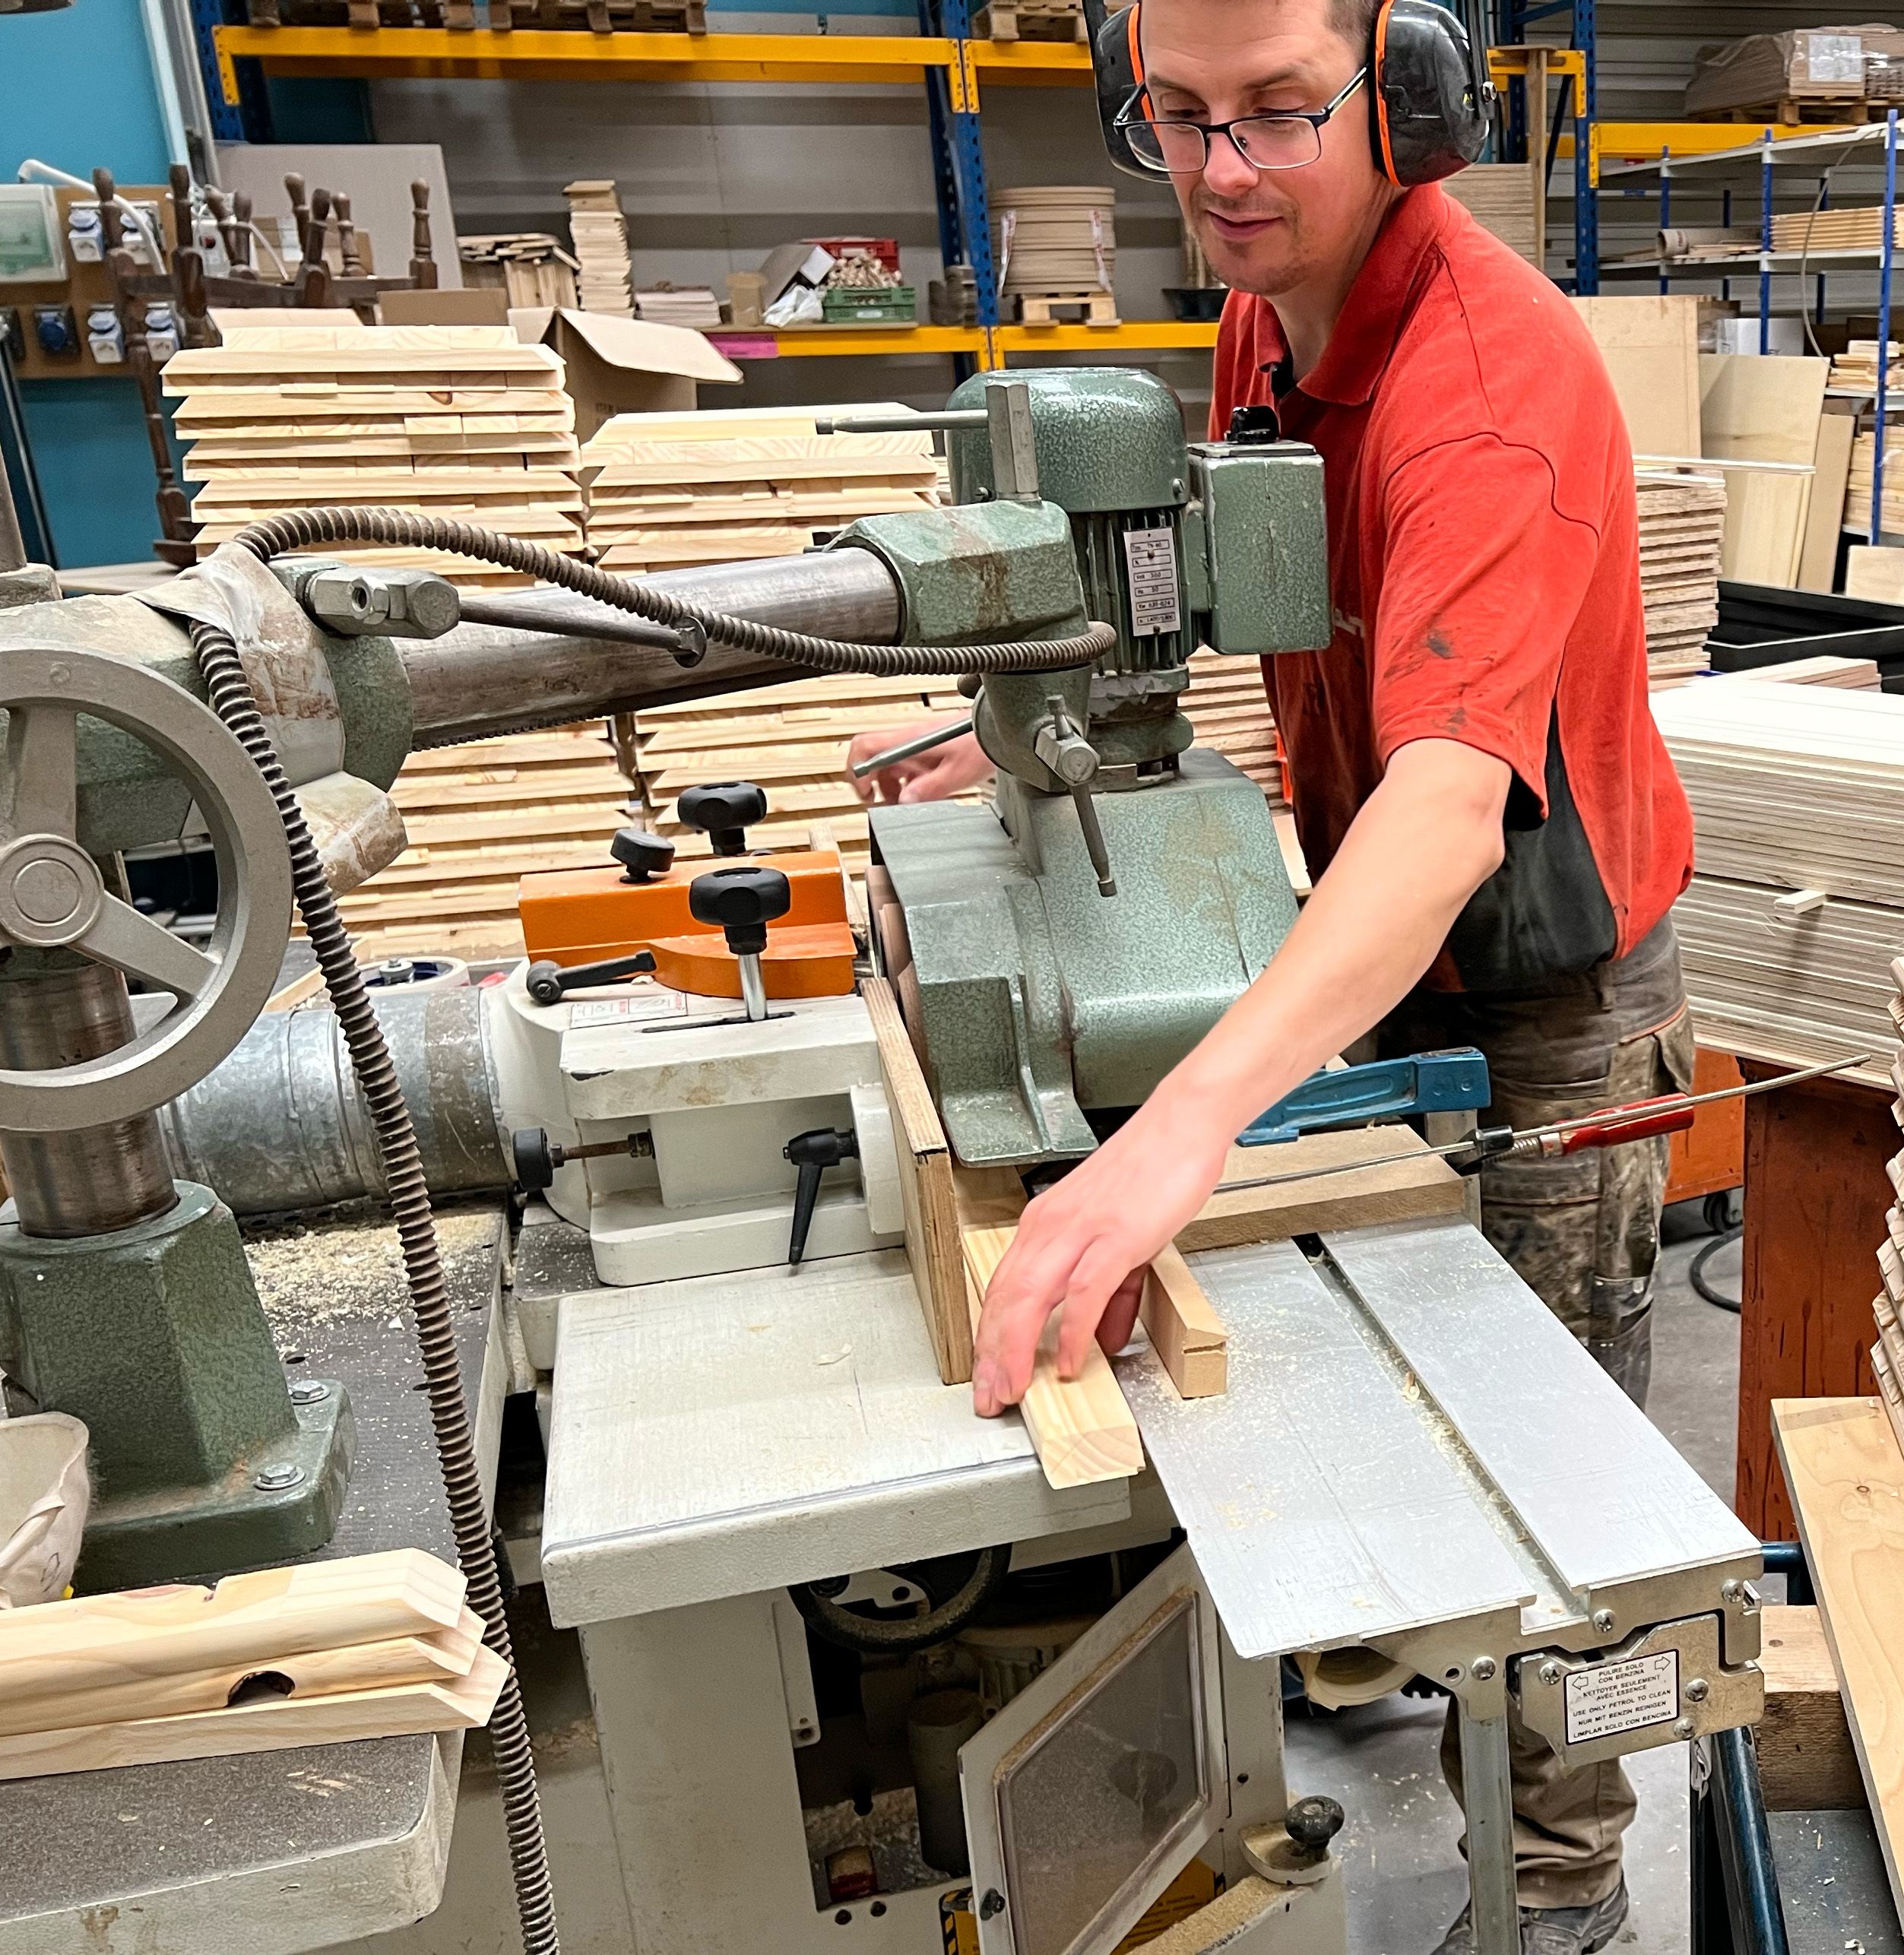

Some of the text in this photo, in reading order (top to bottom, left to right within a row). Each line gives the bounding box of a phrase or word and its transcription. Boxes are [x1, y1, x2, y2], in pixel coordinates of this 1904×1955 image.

[1598, 1662, 1644, 1677] PULIRE SOLO
[1616, 1669, 1645, 1680] BENZINA
[1583, 1675, 1661, 1697] NETTOYER SEULEMENT
[1596, 1684, 1647, 1700] AVEC ESSENCE
[1573, 1708, 1586, 1717] USE
[1609, 1698, 1635, 1709] PETROL
[1649, 1690, 1671, 1699] CLEAN
[1609, 1708, 1633, 1719] BENZIN
[1635, 1700, 1667, 1712] REINIGEN
[1605, 1722, 1623, 1731] SOLO
[1625, 1717, 1640, 1725] CON
[1643, 1710, 1671, 1722] BENCINA
